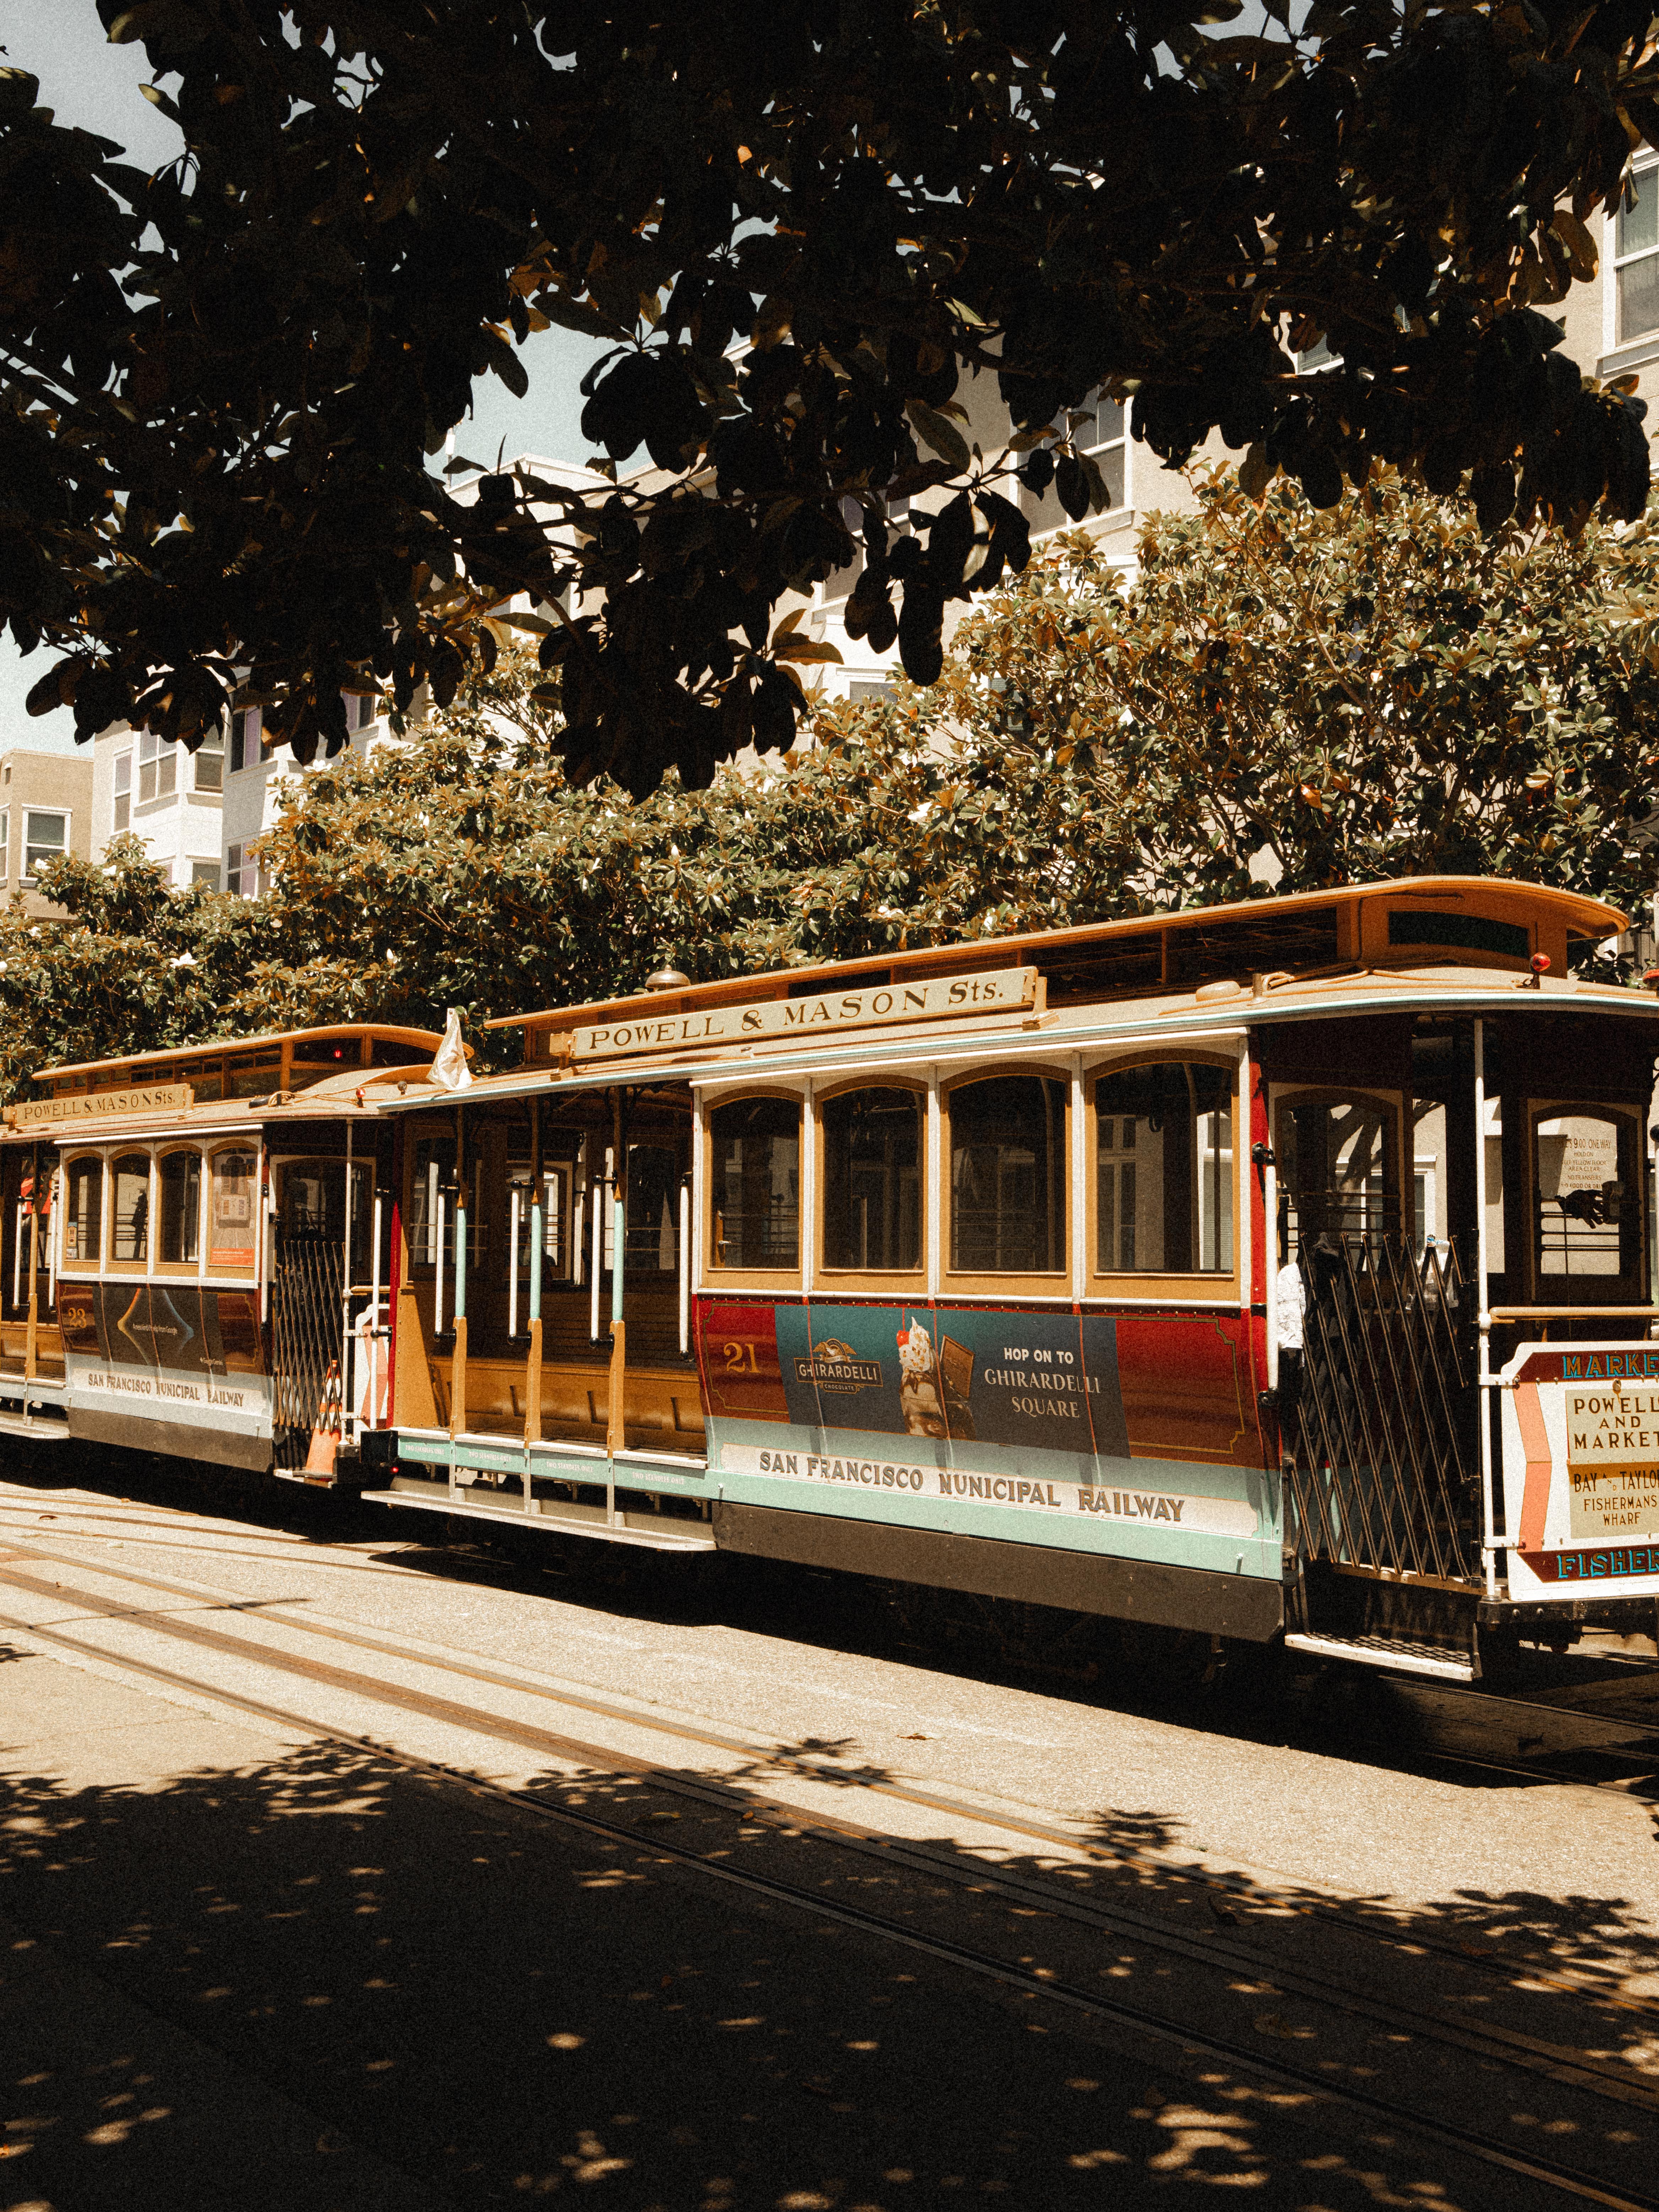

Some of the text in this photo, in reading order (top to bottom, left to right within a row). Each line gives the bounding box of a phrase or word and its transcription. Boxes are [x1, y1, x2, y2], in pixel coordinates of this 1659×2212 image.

[591, 980, 1003, 1050] POWELL & MASON Sts.
[23, 1091, 175, 1119] POWELL & MASON Sts.
[1588, 1139, 1599, 1149] ONE
[1600, 1139, 1611, 1149] WAY
[69, 1307, 86, 1328] 23
[724, 1342, 761, 1373] 21
[1004, 1348, 1073, 1364] HOP ON TO
[799, 1364, 877, 1380] GHIRARDELLI
[985, 1369, 1100, 1393] GHIRARDELLI
[88, 1373, 103, 1387] SAN
[107, 1375, 151, 1394] FRANCISCO
[1012, 1396, 1079, 1418] SQUARE
[1599, 1416, 1641, 1428] AND
[760, 1451, 798, 1474] SAN
[807, 1456, 924, 1491] FRANCISCO
[1078, 1489, 1185, 1522] RAILWAY
[1573, 1473, 1597, 1492] BAY
[1603, 1473, 1617, 1491] AND
[1584, 1495, 1657, 1511] FISHERMANS
[1604, 1512, 1641, 1526] WHARF
